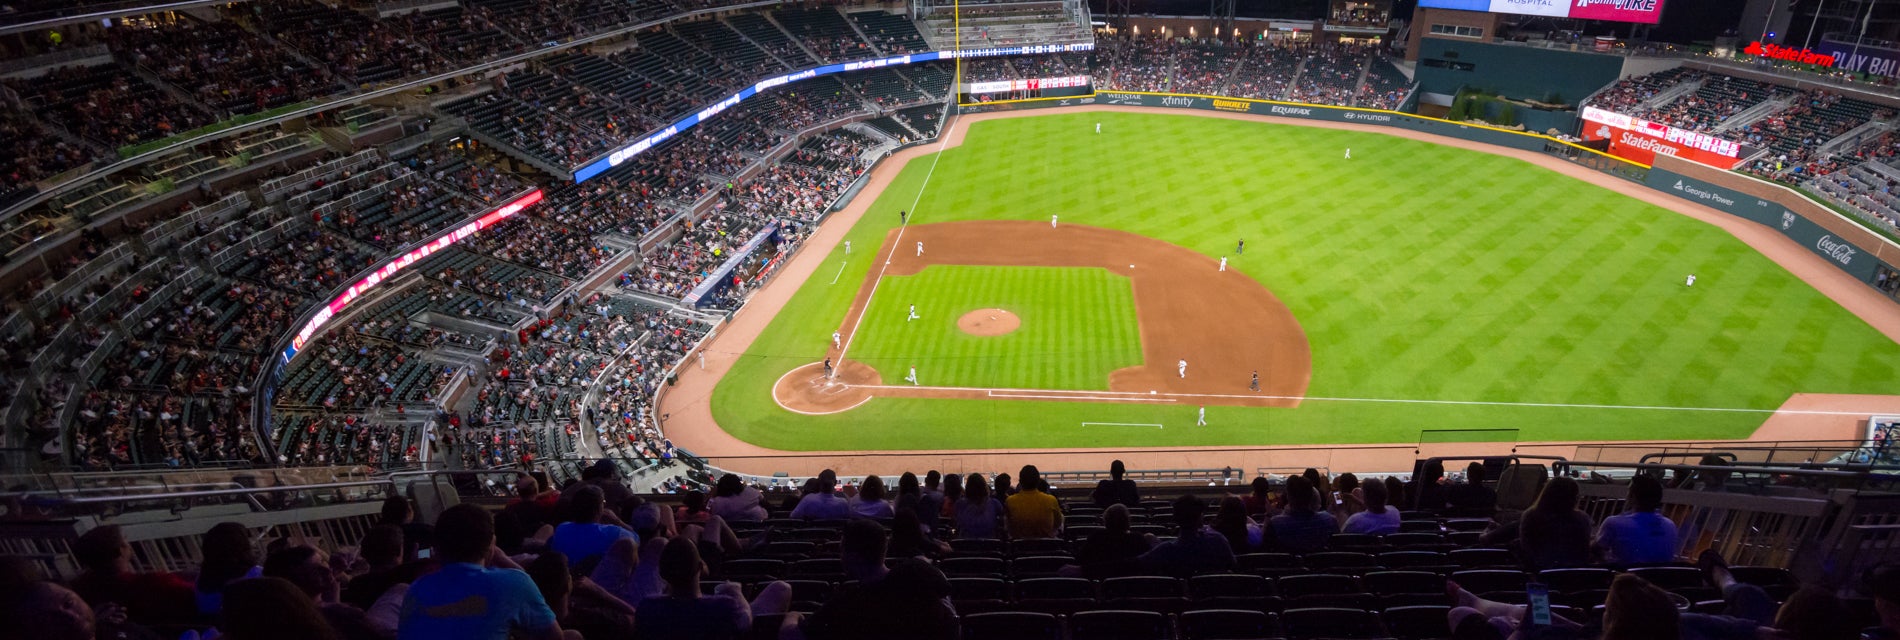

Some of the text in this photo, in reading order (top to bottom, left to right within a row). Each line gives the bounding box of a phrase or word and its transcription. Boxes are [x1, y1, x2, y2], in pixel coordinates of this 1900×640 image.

[1832, 51, 1868, 72] PLAY
[1162, 96, 1193, 107] xfinity
[1271, 105, 1312, 115] EQUIFAX
[1356, 113, 1391, 122] HYUNDAI
[1684, 185, 1734, 206] Georgia Power
